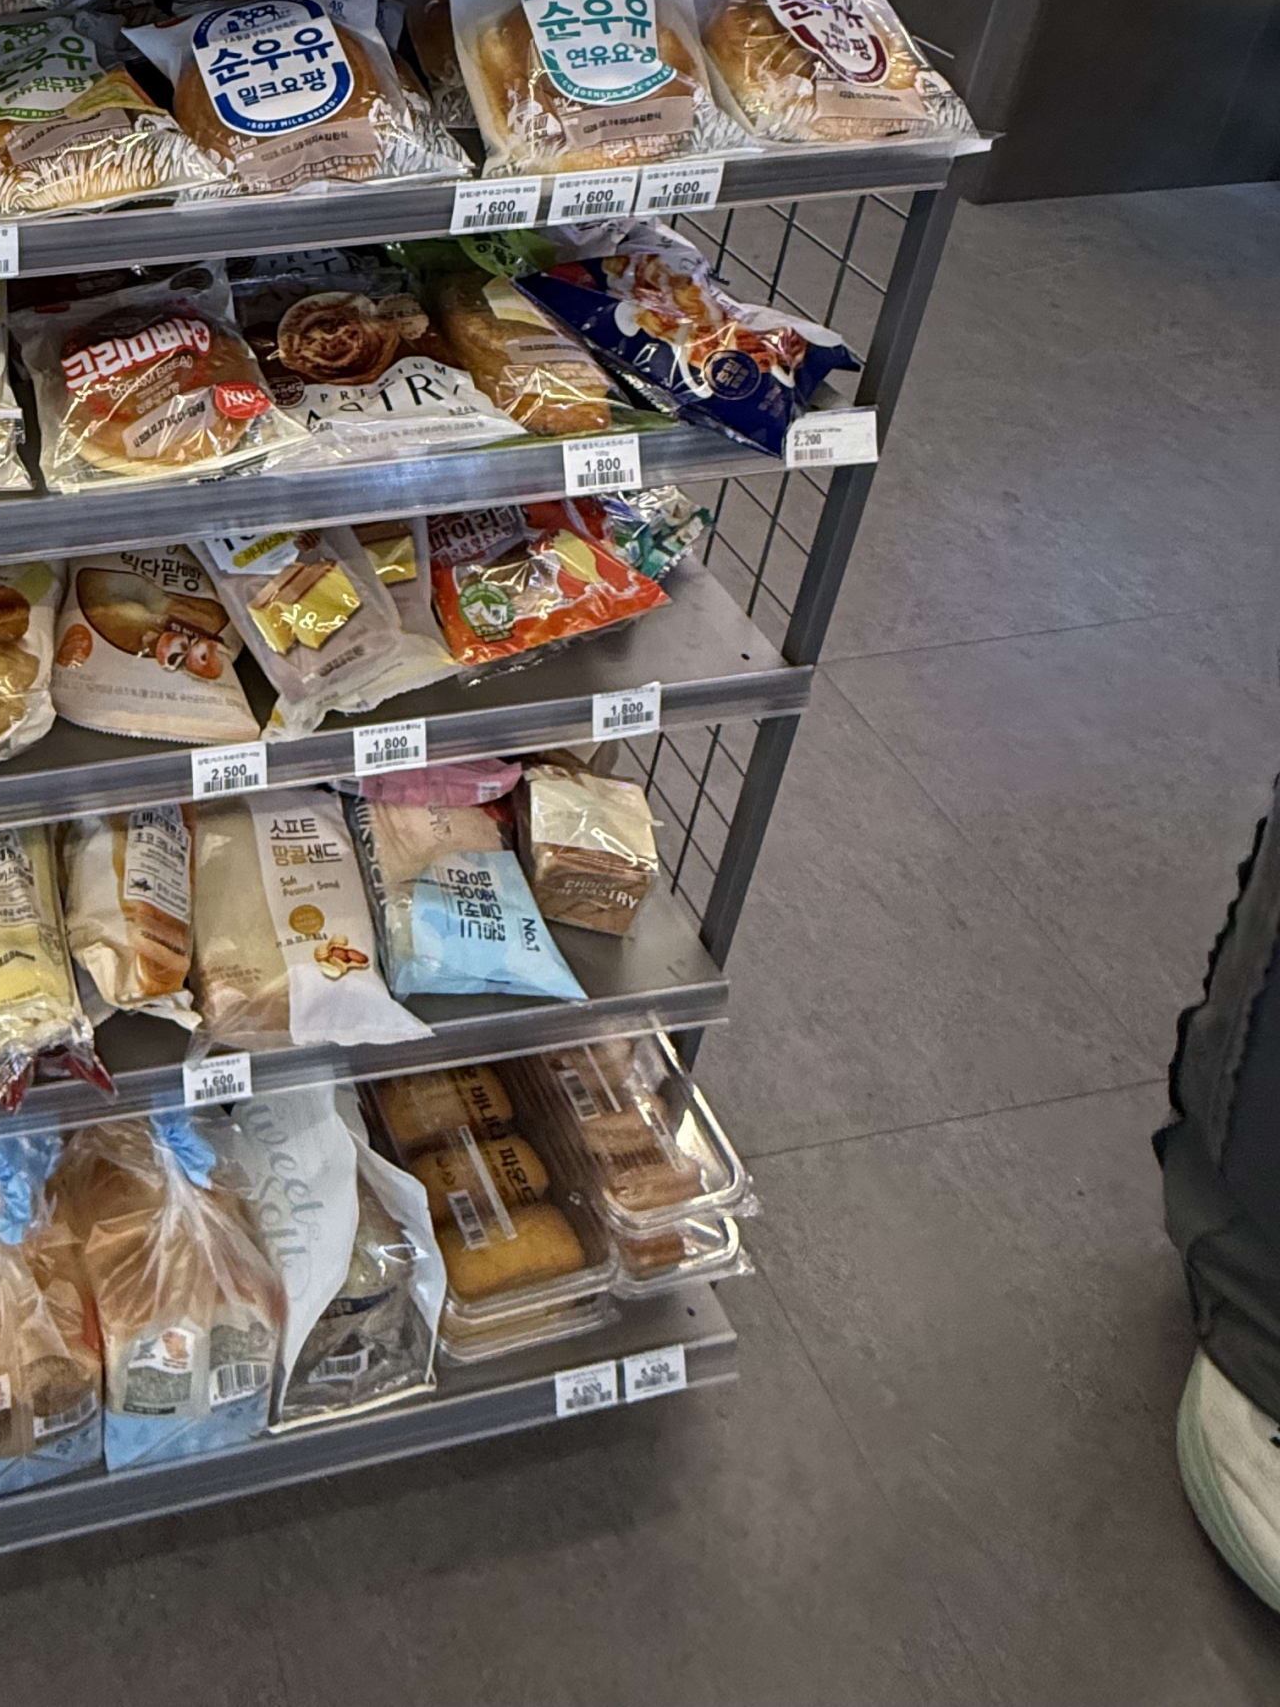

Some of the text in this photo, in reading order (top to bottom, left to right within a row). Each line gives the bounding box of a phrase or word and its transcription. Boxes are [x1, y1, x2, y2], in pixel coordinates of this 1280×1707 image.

[207, 27, 335, 87] 순우유
[237, 68, 328, 107] 밀크요팡
[573, 188, 614, 204] 1,600
[660, 180, 701, 196] 1,600
[475, 198, 517, 216] 1,600
[108, 354, 195, 401] CREAM BREAD
[584, 457, 621, 472] 1,800
[610, 701, 644, 717] 1,800
[372, 735, 408, 752] 1,800
[210, 764, 248, 780] 2,500
[269, 818, 317, 838] 소프트
[271, 842, 343, 866] 땅콩샌드
[521, 915, 541, 953] No.1
